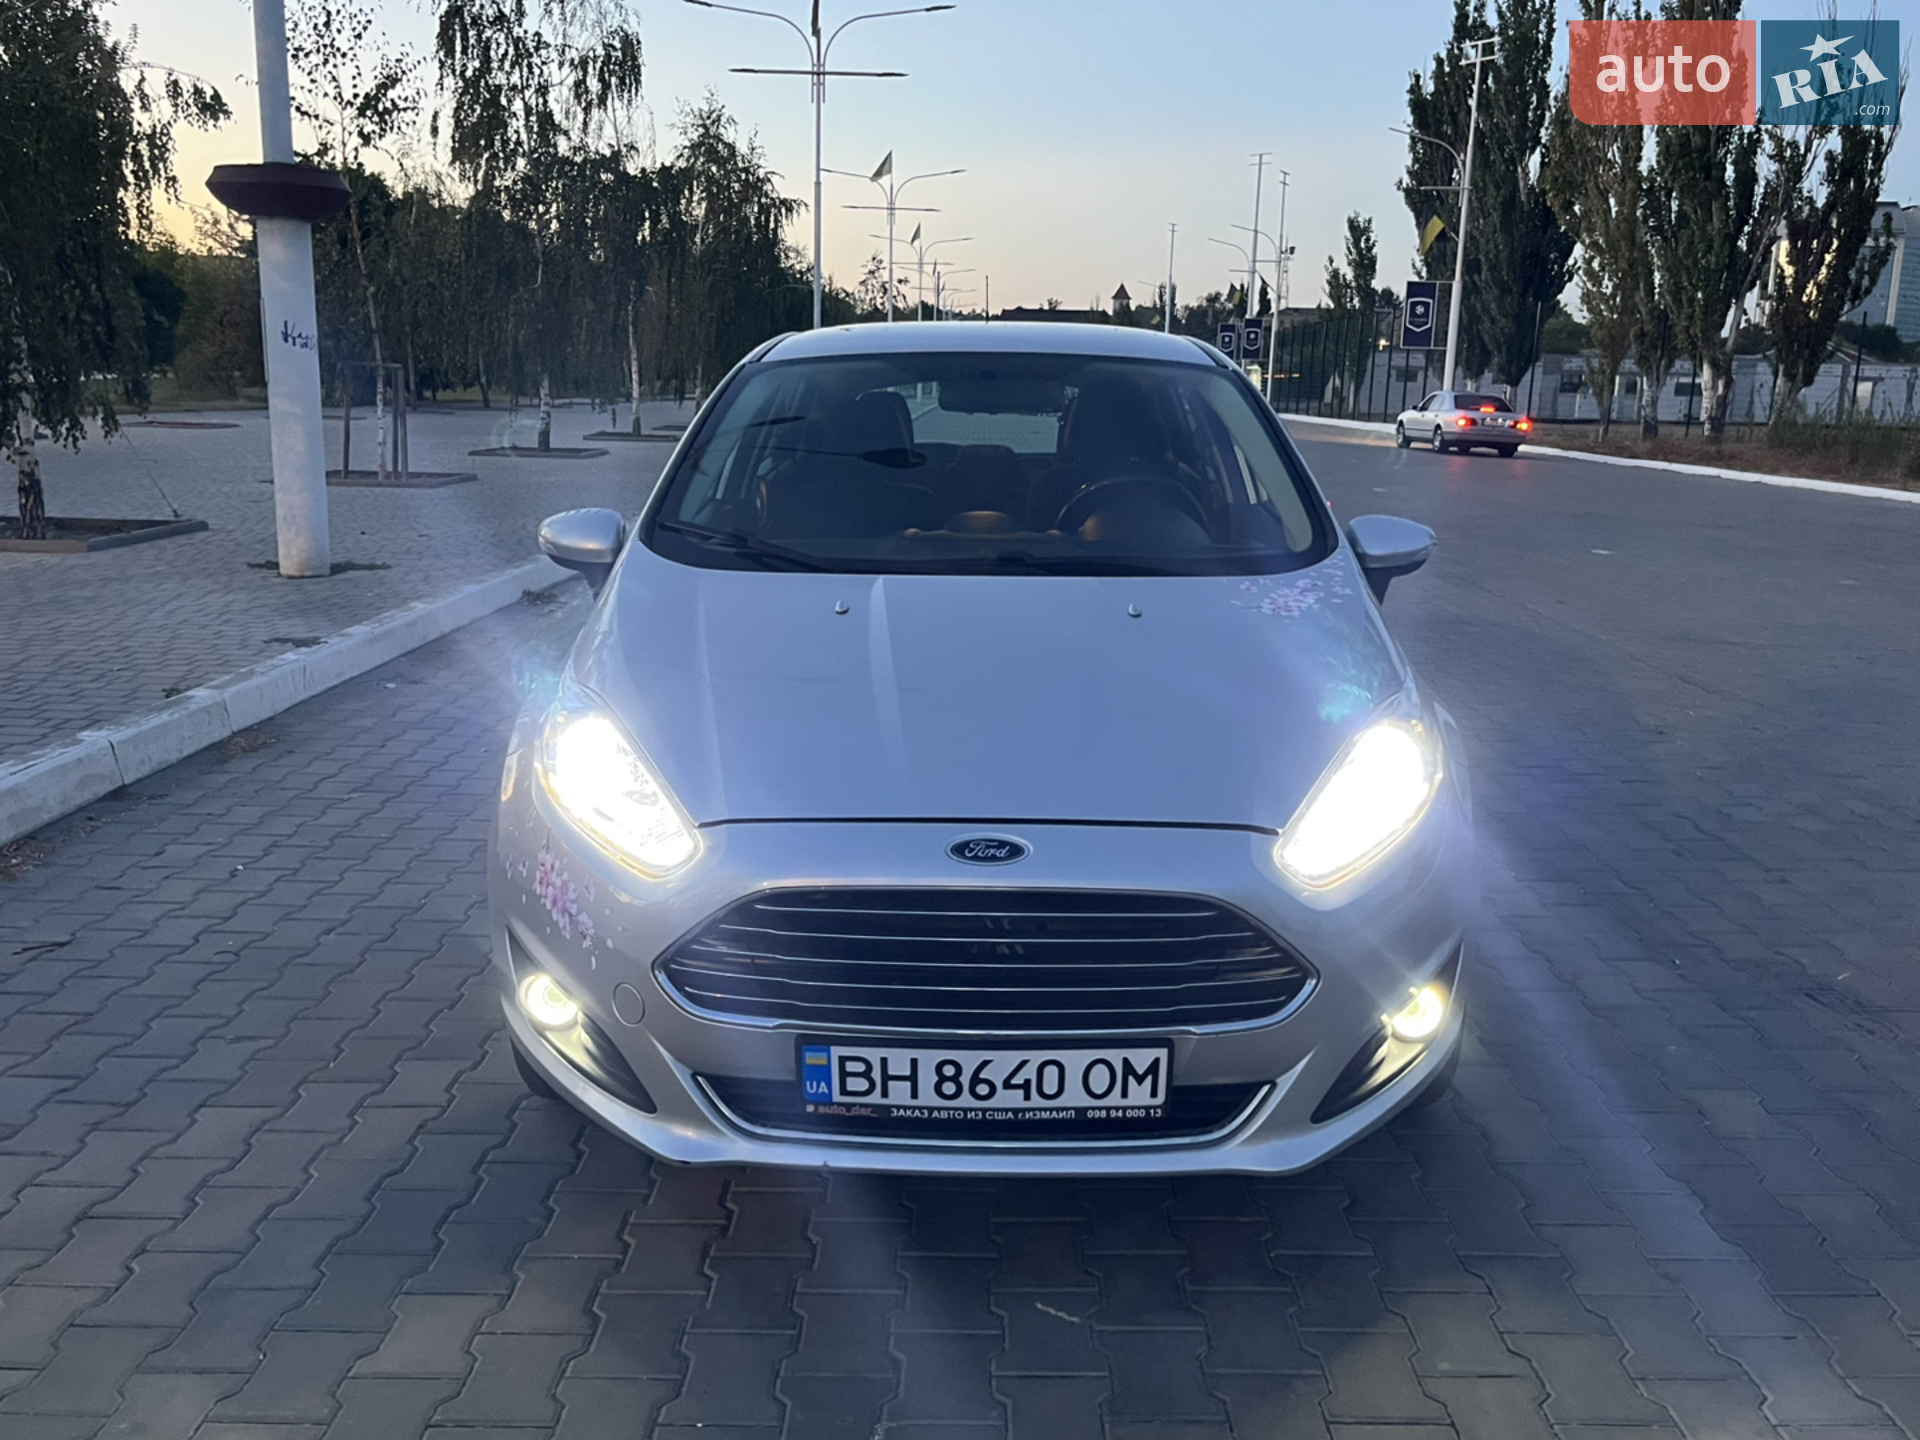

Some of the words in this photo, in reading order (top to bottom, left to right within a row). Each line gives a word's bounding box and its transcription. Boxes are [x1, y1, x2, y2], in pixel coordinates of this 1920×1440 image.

[965, 840, 1010, 857] Ford
[838, 1055, 918, 1100] BH
[933, 1058, 1065, 1102] 8640
[1081, 1056, 1161, 1100] OM
[806, 1080, 829, 1094] UA
[890, 1107, 929, 1118] ЗАКАЗ
[931, 1110, 963, 1119] АВТО
[967, 1110, 982, 1120] ИЗ
[986, 1110, 1014, 1120] США
[1086, 1109, 1107, 1119] 098
[1109, 1109, 1123, 1118] 94
[1126, 1109, 1146, 1118] 000
[1149, 1108, 1162, 1118] 13
